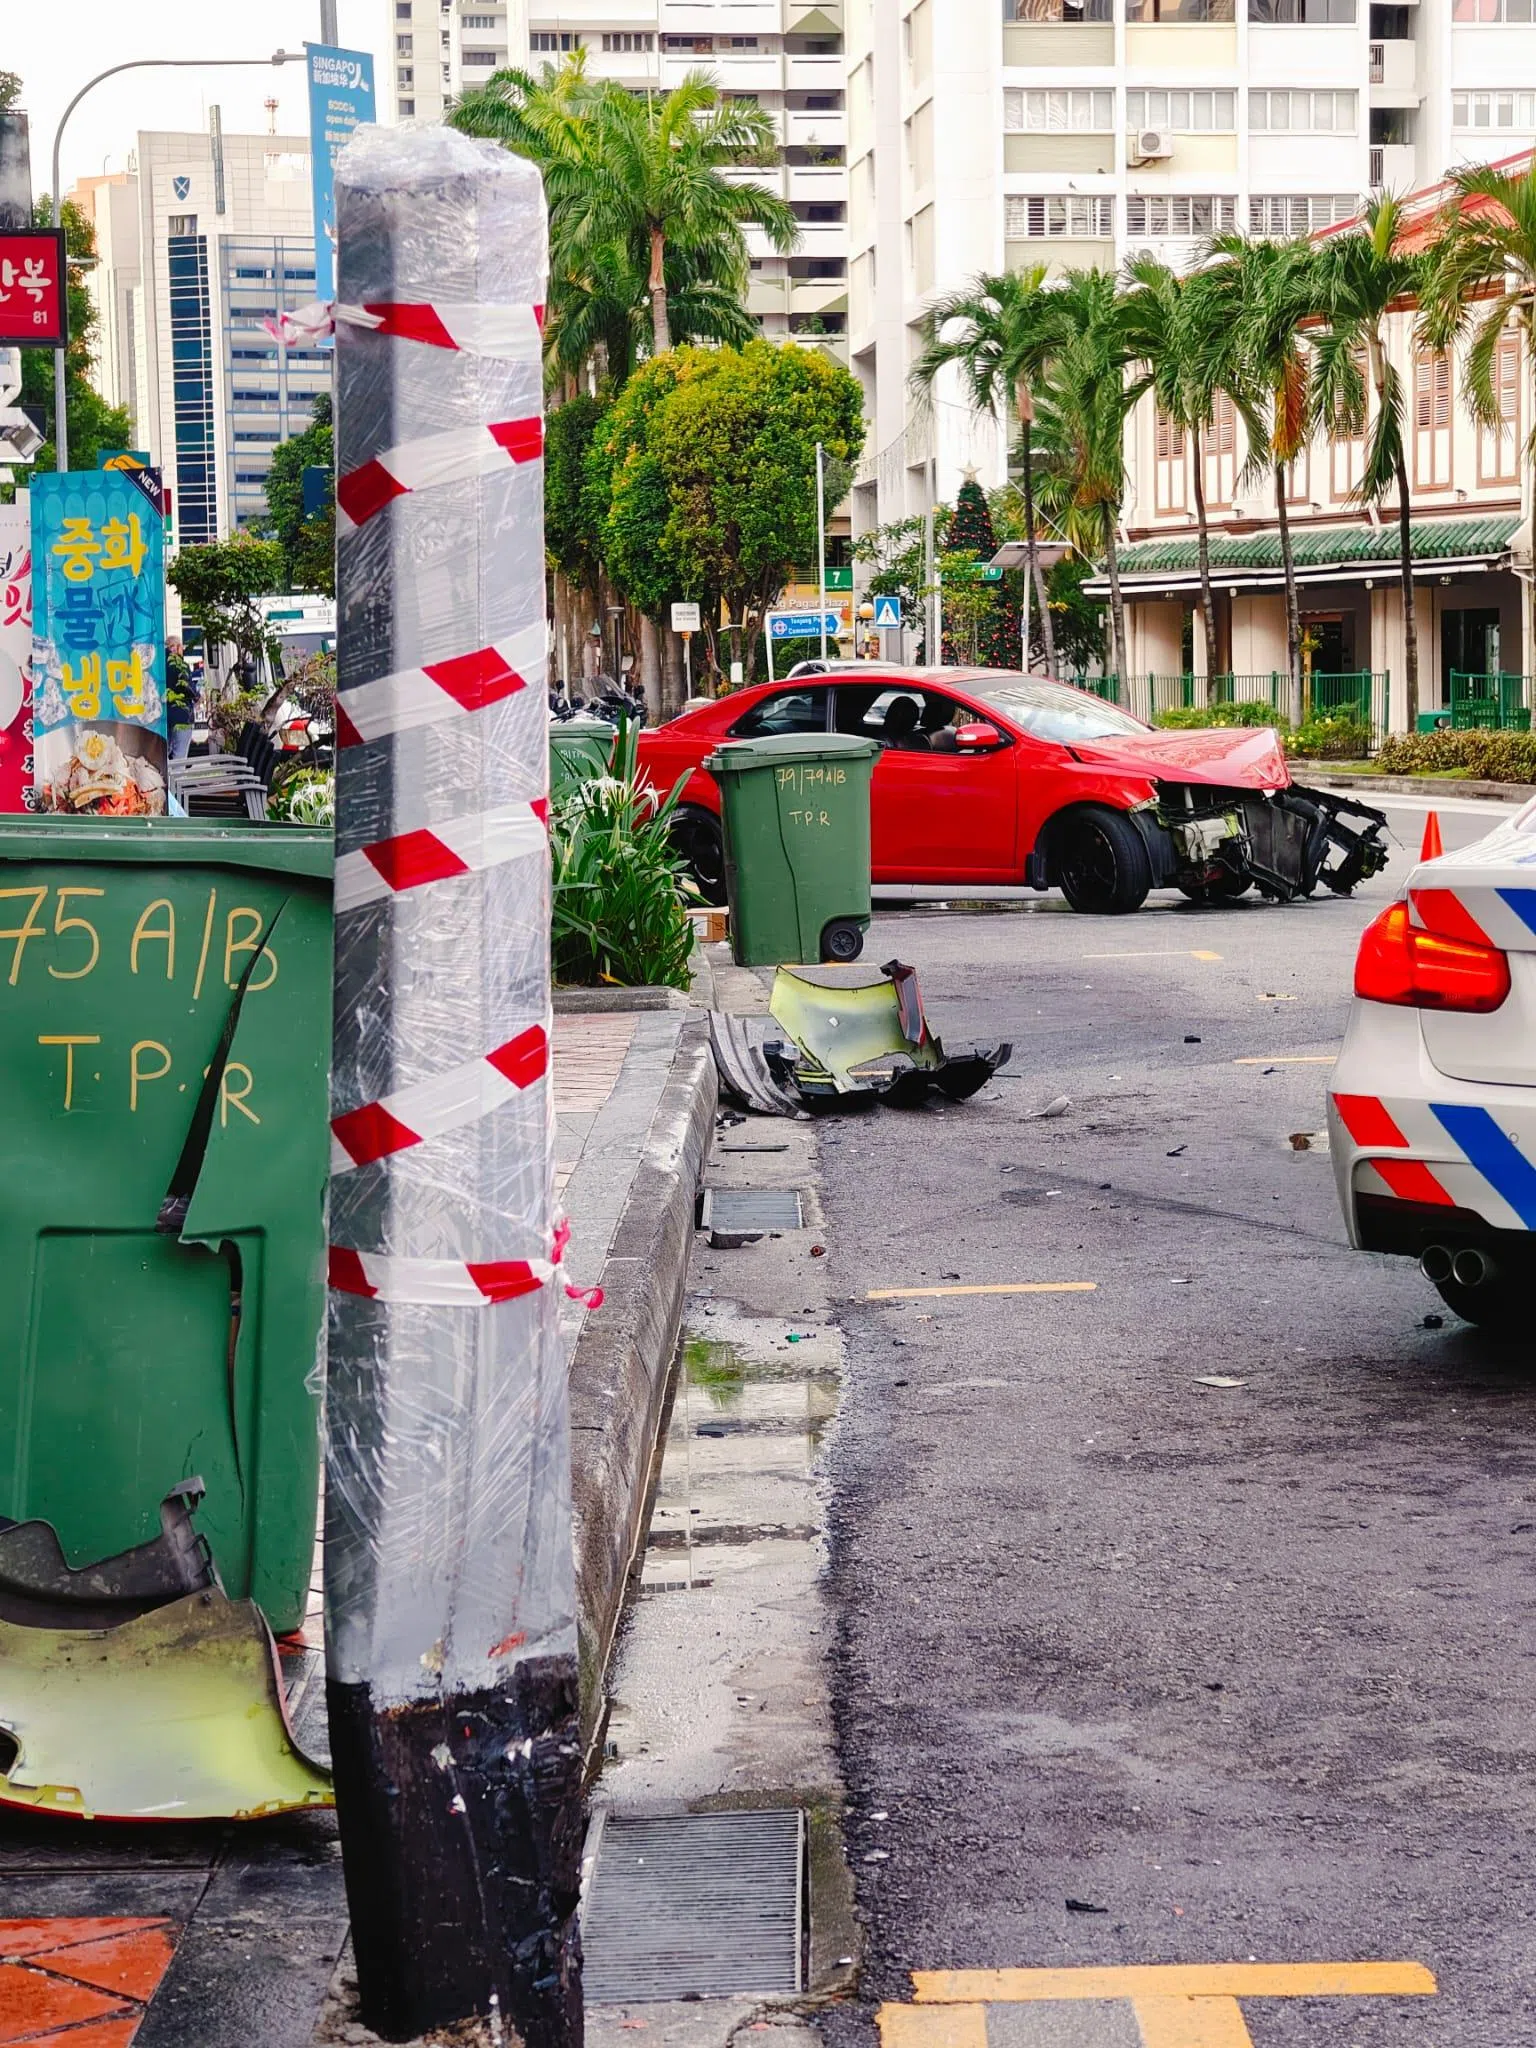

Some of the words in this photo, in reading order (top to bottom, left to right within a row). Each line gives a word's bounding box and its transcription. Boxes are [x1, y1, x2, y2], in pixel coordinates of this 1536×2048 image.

[33, 310, 48, 324] 81
[138, 471, 161, 497] NEW
[52, 512, 149, 582] 중화
[832, 571, 841, 584] 7
[789, 599, 819, 609] Pagar
[54, 587, 105, 650] 물
[62, 651, 145, 719] 냉면
